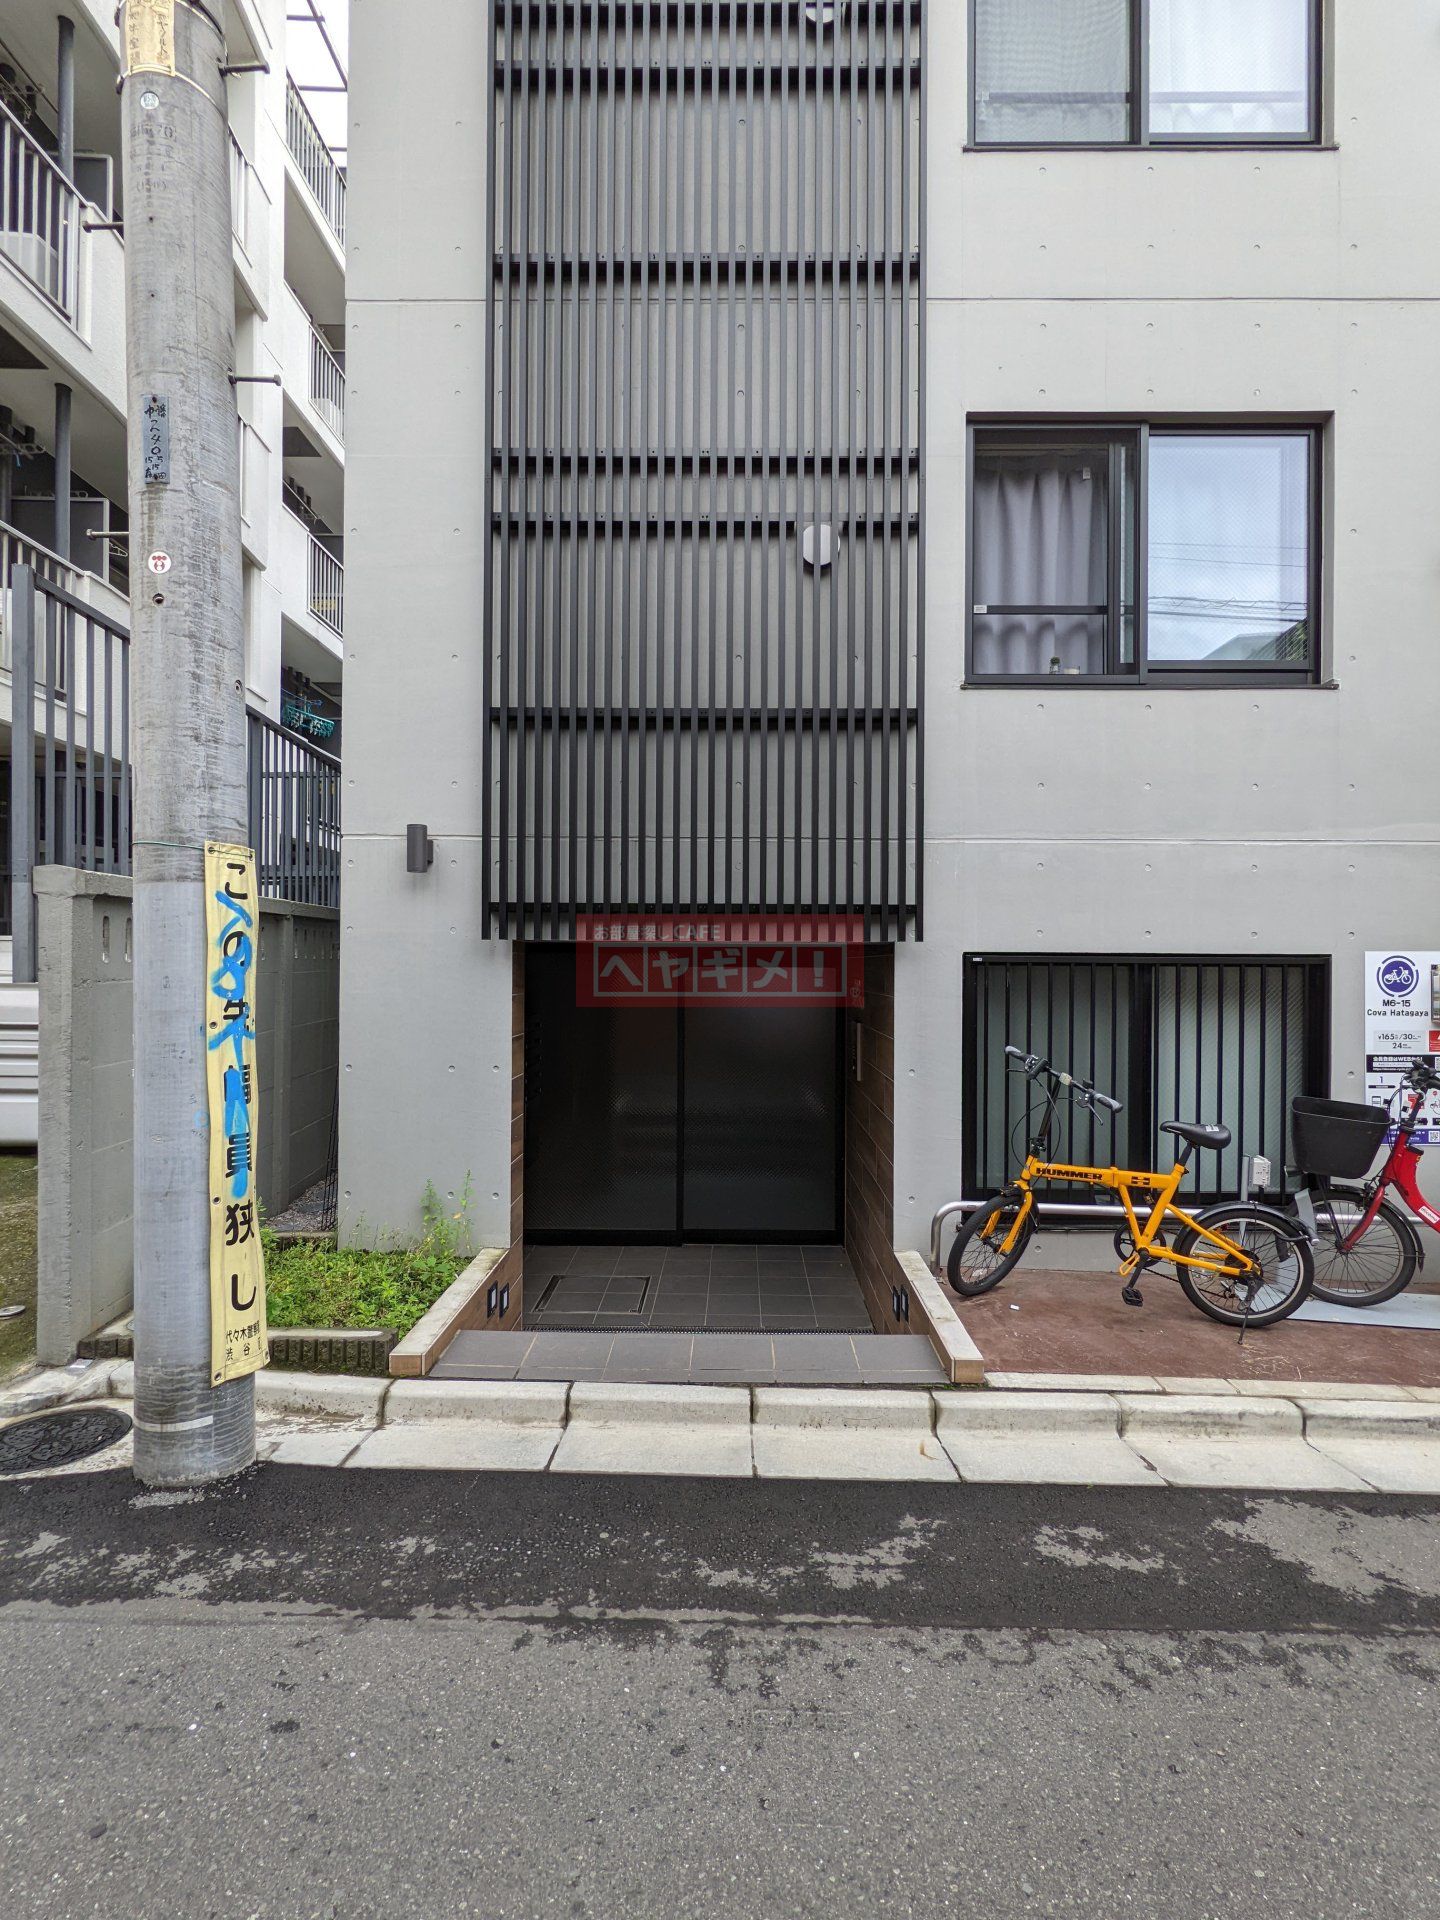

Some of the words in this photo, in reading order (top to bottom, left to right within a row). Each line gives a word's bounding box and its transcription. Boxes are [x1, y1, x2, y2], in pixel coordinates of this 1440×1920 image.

[1382, 999, 1411, 1008] M6-15
[1366, 1008, 1387, 1016] Cova
[1390, 1009, 1429, 1018] Hatagaya
[1036, 1167, 1103, 1181] HUMMER
